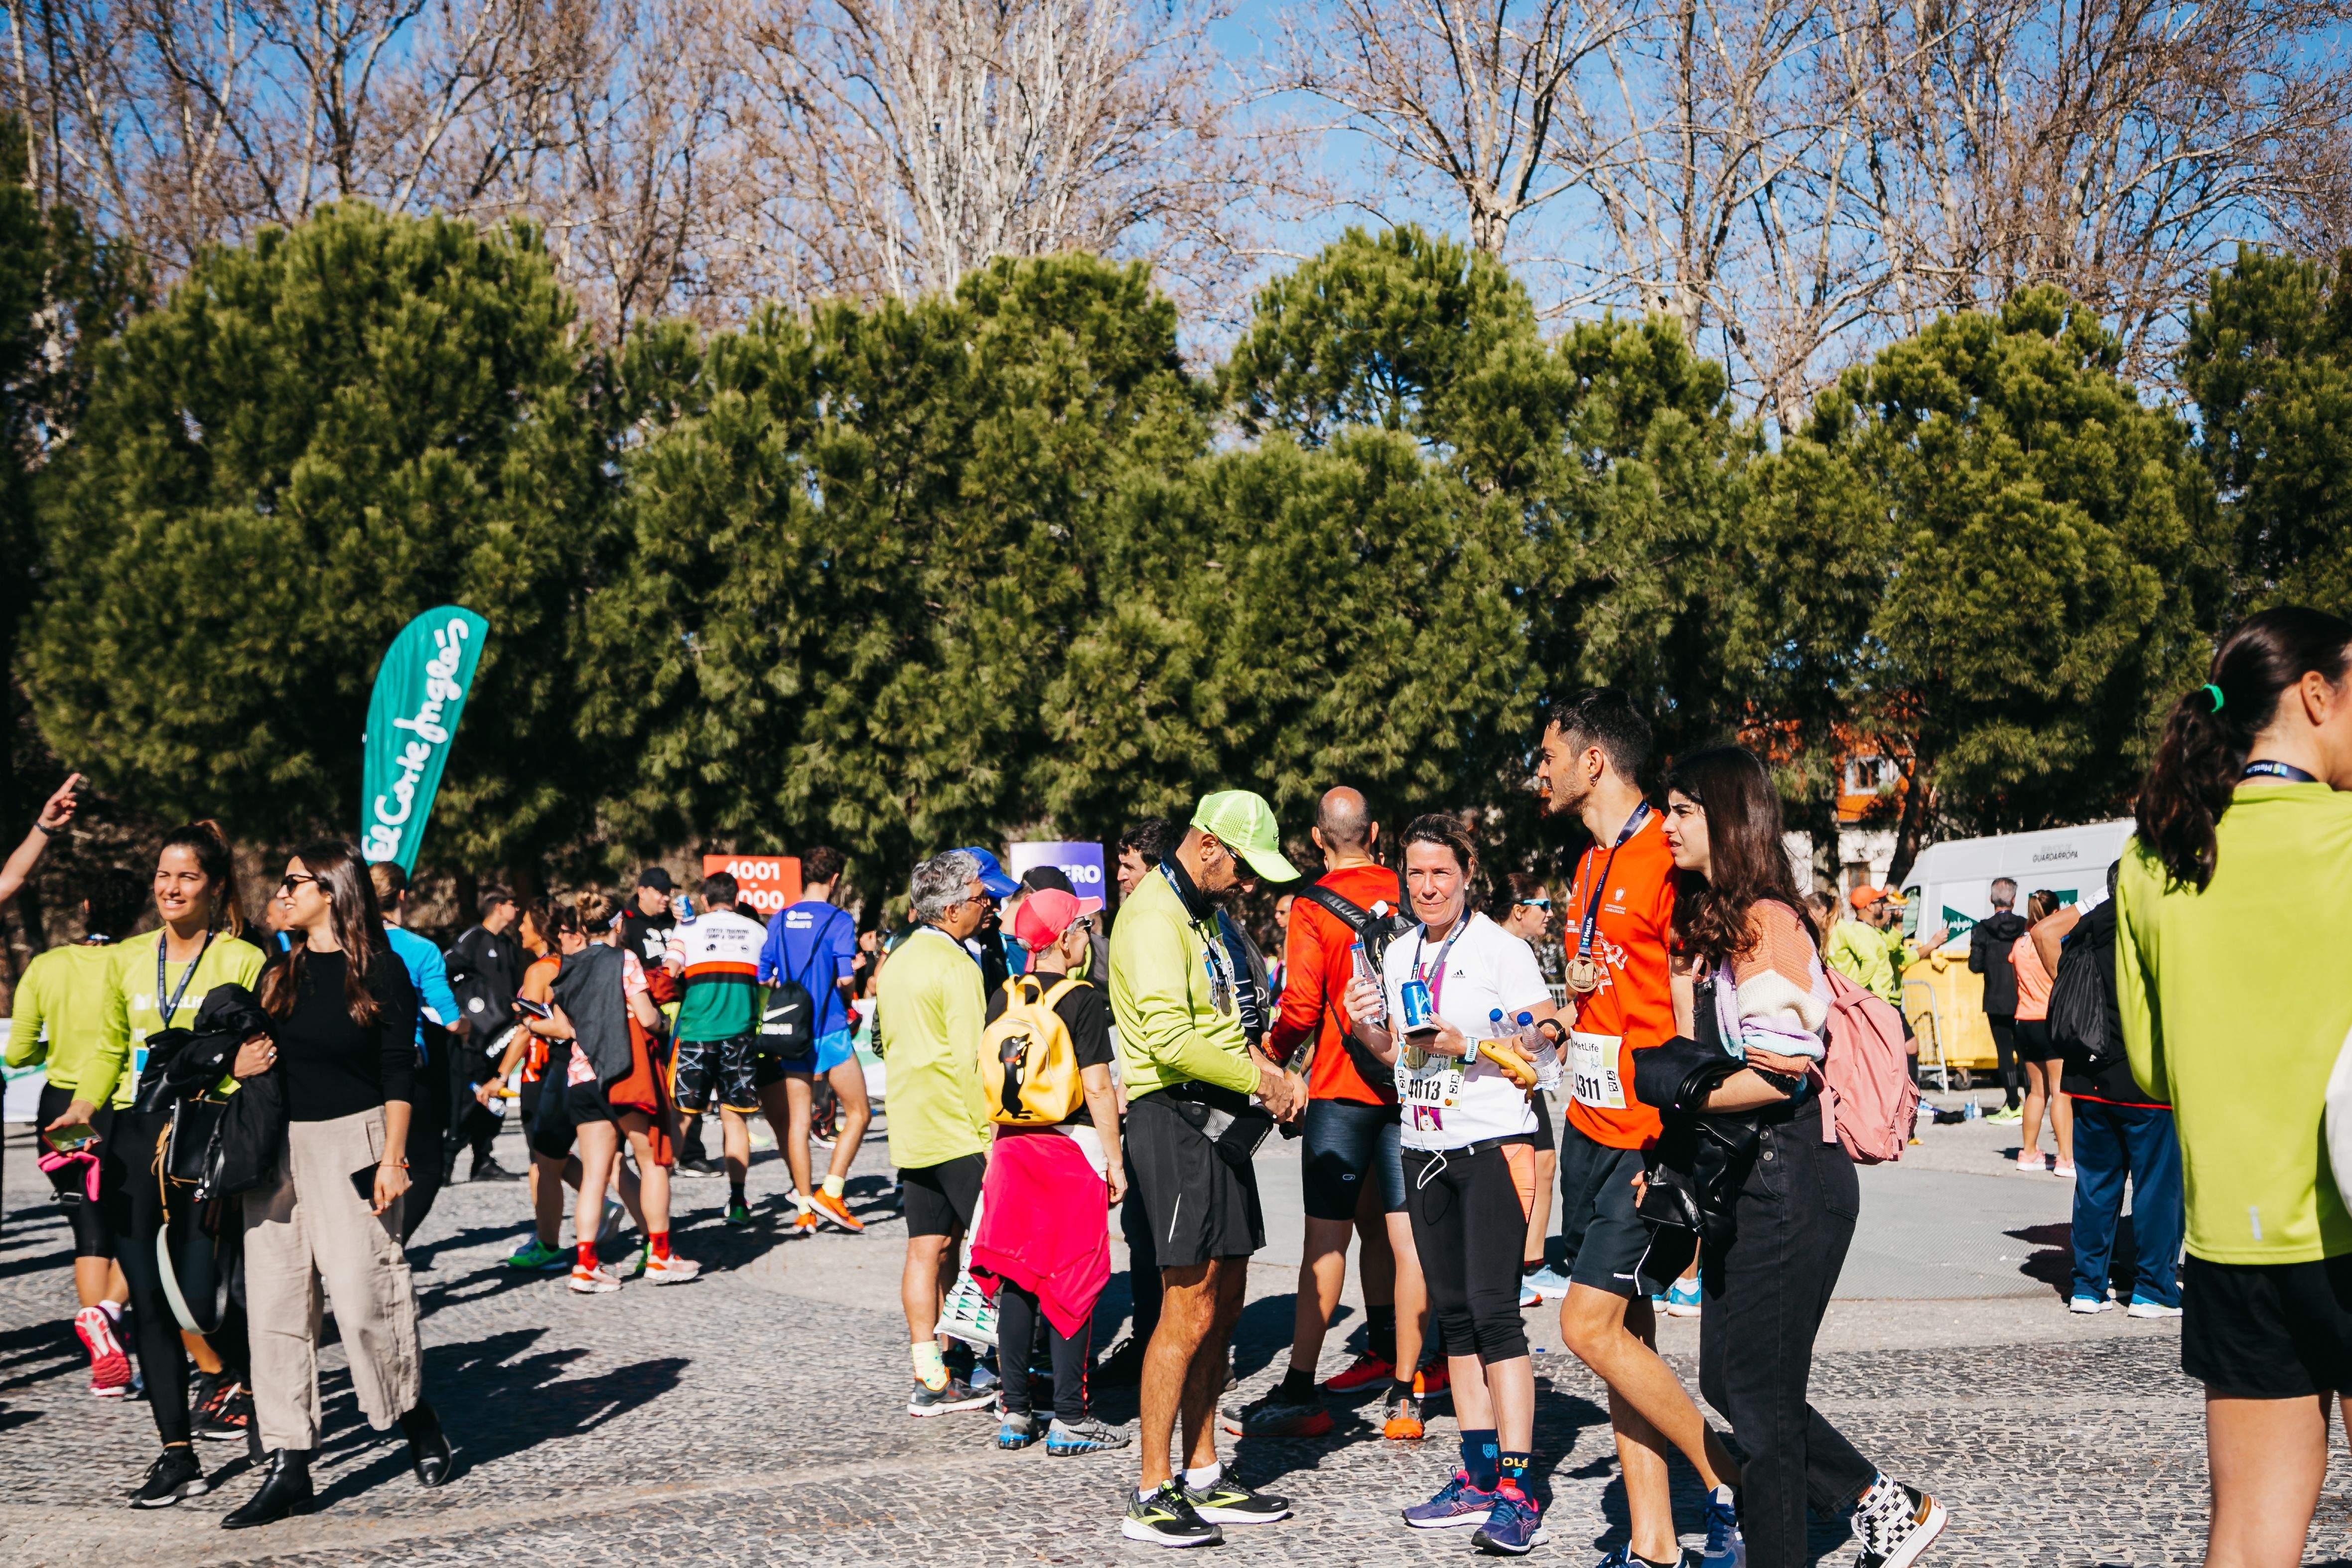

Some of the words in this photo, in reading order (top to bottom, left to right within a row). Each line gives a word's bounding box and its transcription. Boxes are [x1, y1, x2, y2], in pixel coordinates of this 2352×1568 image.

[374, 741, 431, 826] Corte
[361, 825, 402, 862] El
[725, 860, 781, 881] 4001
[1059, 863, 1102, 884] ERO
[738, 889, 785, 910] 000
[1584, 917, 1593, 938] MetLife
[1573, 1041, 1599, 1052] MetLife
[1503, 1457, 1528, 1468] OLÉ
